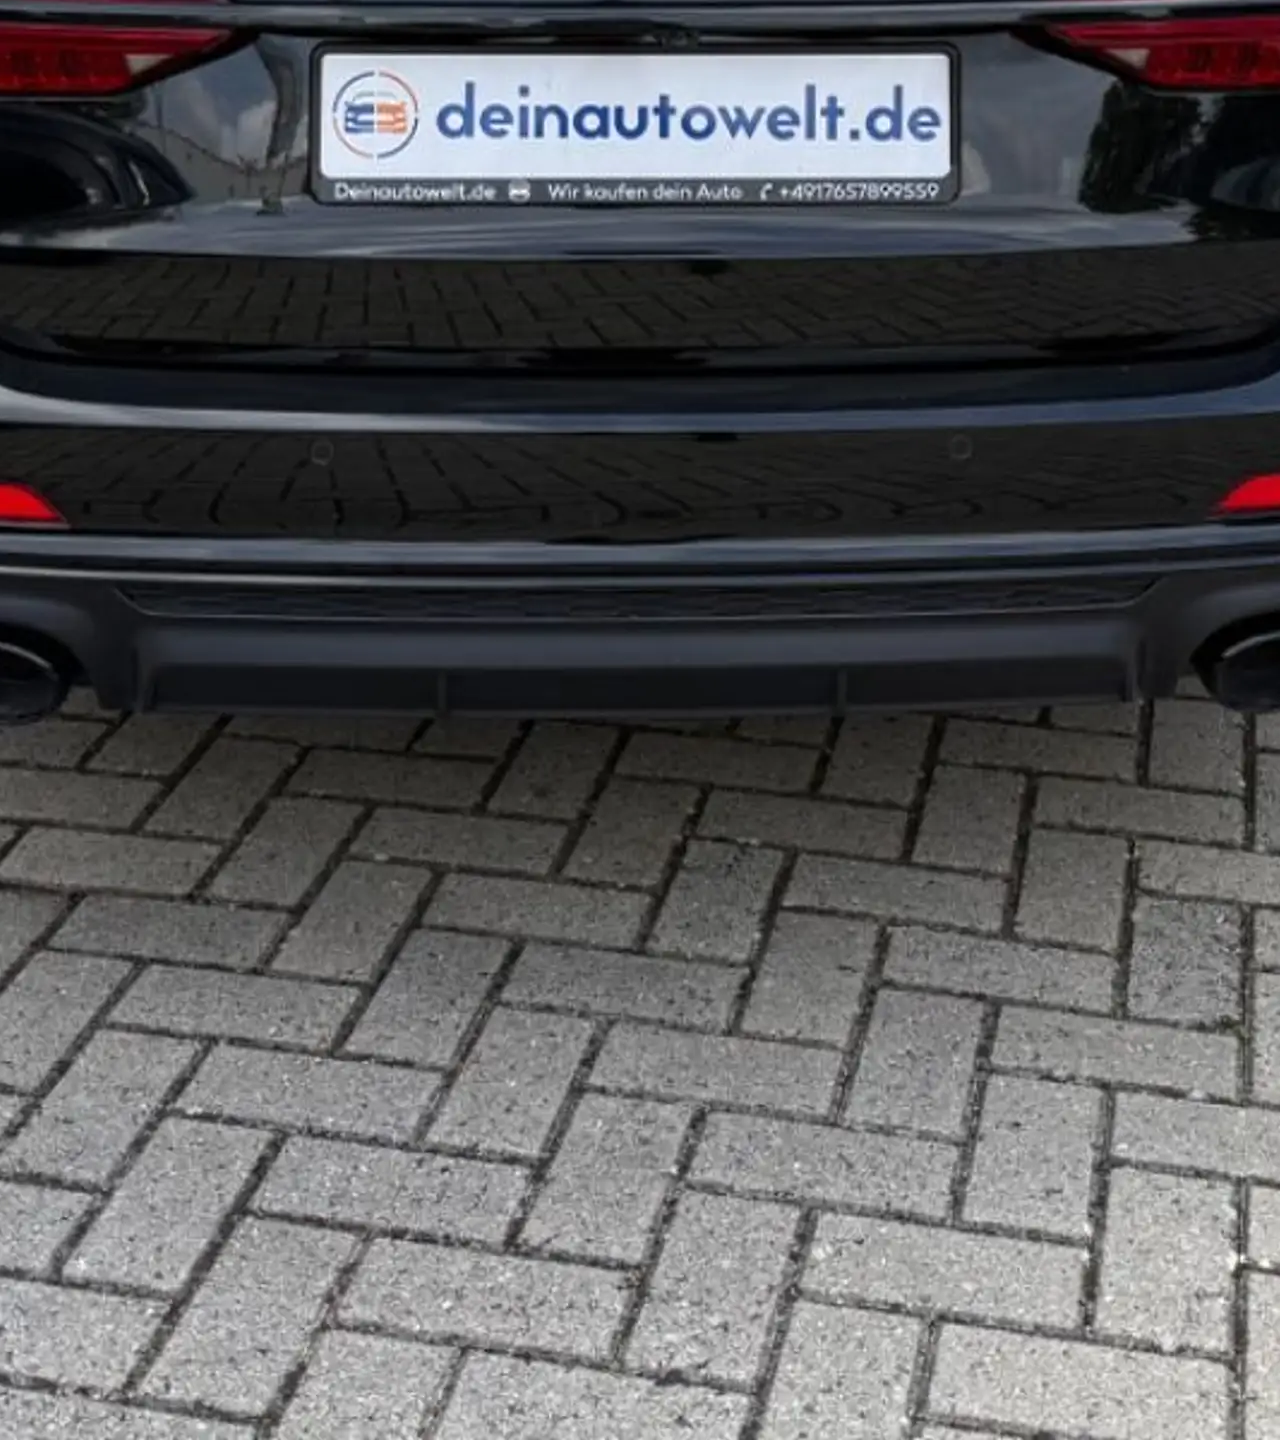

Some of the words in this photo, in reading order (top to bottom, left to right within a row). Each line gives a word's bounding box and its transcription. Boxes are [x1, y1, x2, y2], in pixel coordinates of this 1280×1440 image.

[436, 81, 941, 141] deinautowelt.de
[333, 181, 497, 201] Deinautowelt.de
[547, 182, 580, 201] Wir
[583, 182, 649, 201] kaufen
[652, 182, 693, 201] dein
[695, 182, 744, 201] Auto
[779, 182, 940, 201] +4917657899559
